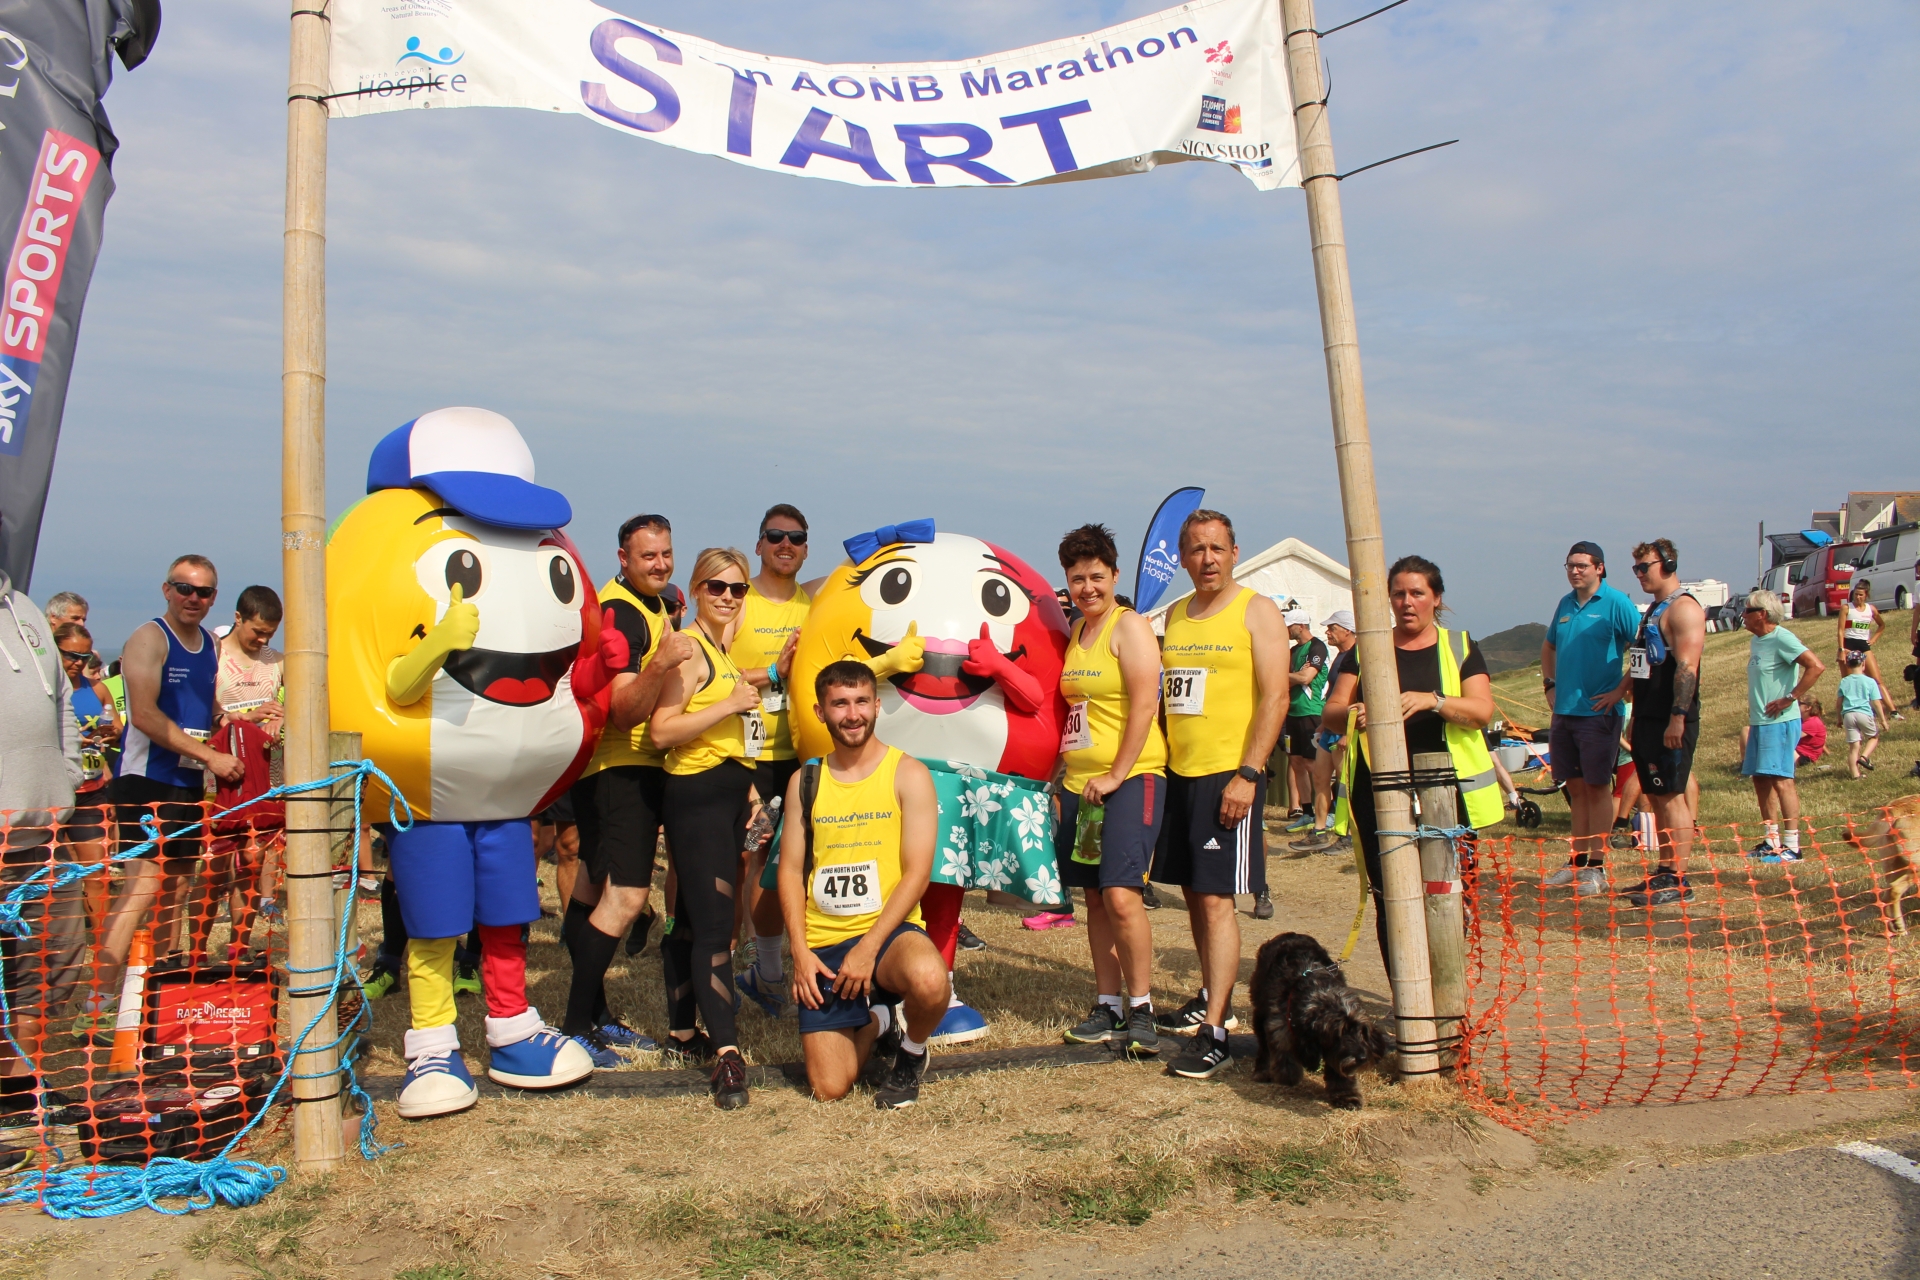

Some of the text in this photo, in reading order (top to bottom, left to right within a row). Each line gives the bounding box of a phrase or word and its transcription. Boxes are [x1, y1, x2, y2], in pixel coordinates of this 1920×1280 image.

[790, 70, 944, 102] AONB
[960, 26, 1199, 99] Marathon
[359, 67, 424, 80] North Devon
[358, 67, 467, 100] Hospice
[3, 142, 88, 352] SPORTS
[1145, 555, 1163, 568] North
[1165, 677, 1193, 698] 381
[876, 811, 892, 820] BAY
[851, 864, 870, 872] DEVON
[824, 874, 868, 898] 478
[177, 1008, 203, 1019] RACE
